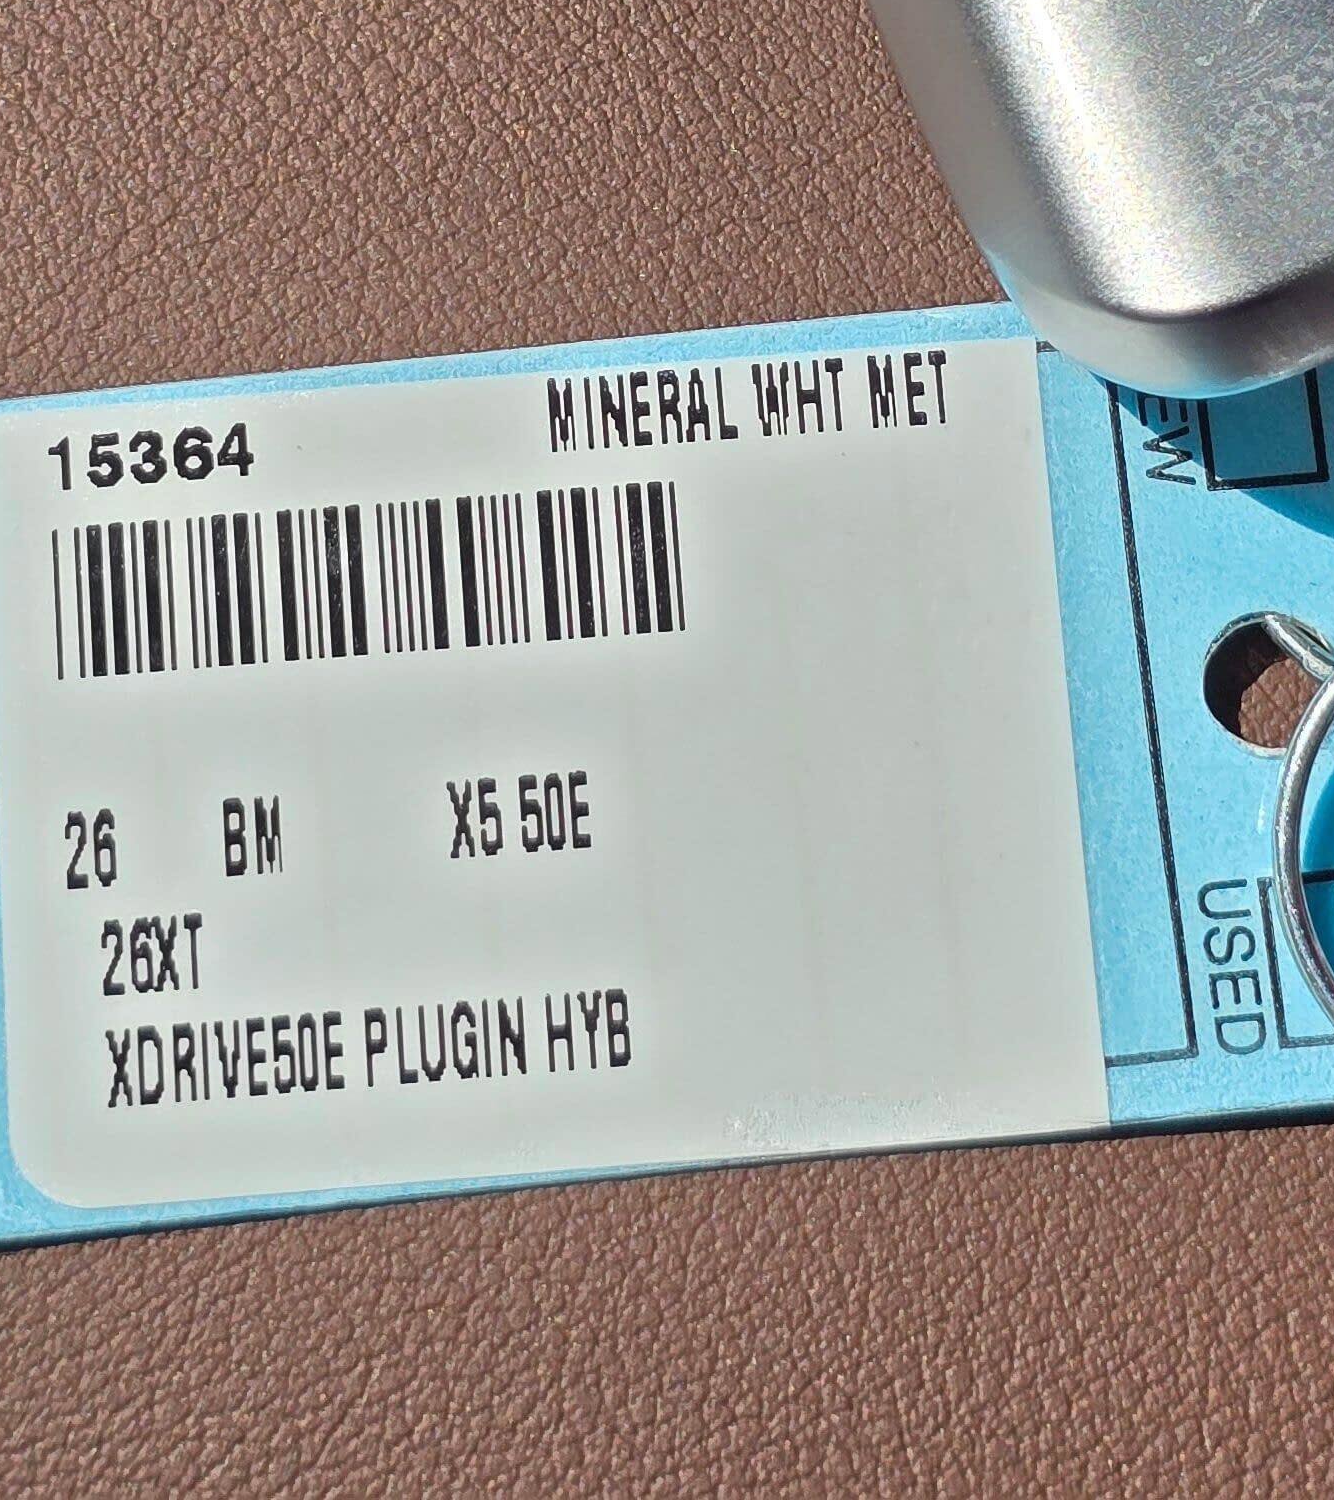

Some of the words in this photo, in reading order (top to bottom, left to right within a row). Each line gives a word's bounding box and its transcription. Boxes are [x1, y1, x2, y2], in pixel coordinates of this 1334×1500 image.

[547, 367, 738, 452] MINERAL
[752, 358, 843, 436] WHT
[867, 350, 946, 428] MET
[1136, 394, 1197, 486] EW
[48, 423, 254, 490] 15364
[65, 809, 116, 889] 26
[223, 796, 282, 876] BM
[447, 779, 503, 858] X5
[519, 771, 591, 852] 50E
[102, 914, 202, 996] 26XT
[1197, 878, 1267, 1056] USED
[106, 1012, 344, 1108] XDRIVE50E
[365, 998, 526, 1087] PLUGIN
[546, 989, 631, 1072] HYB
